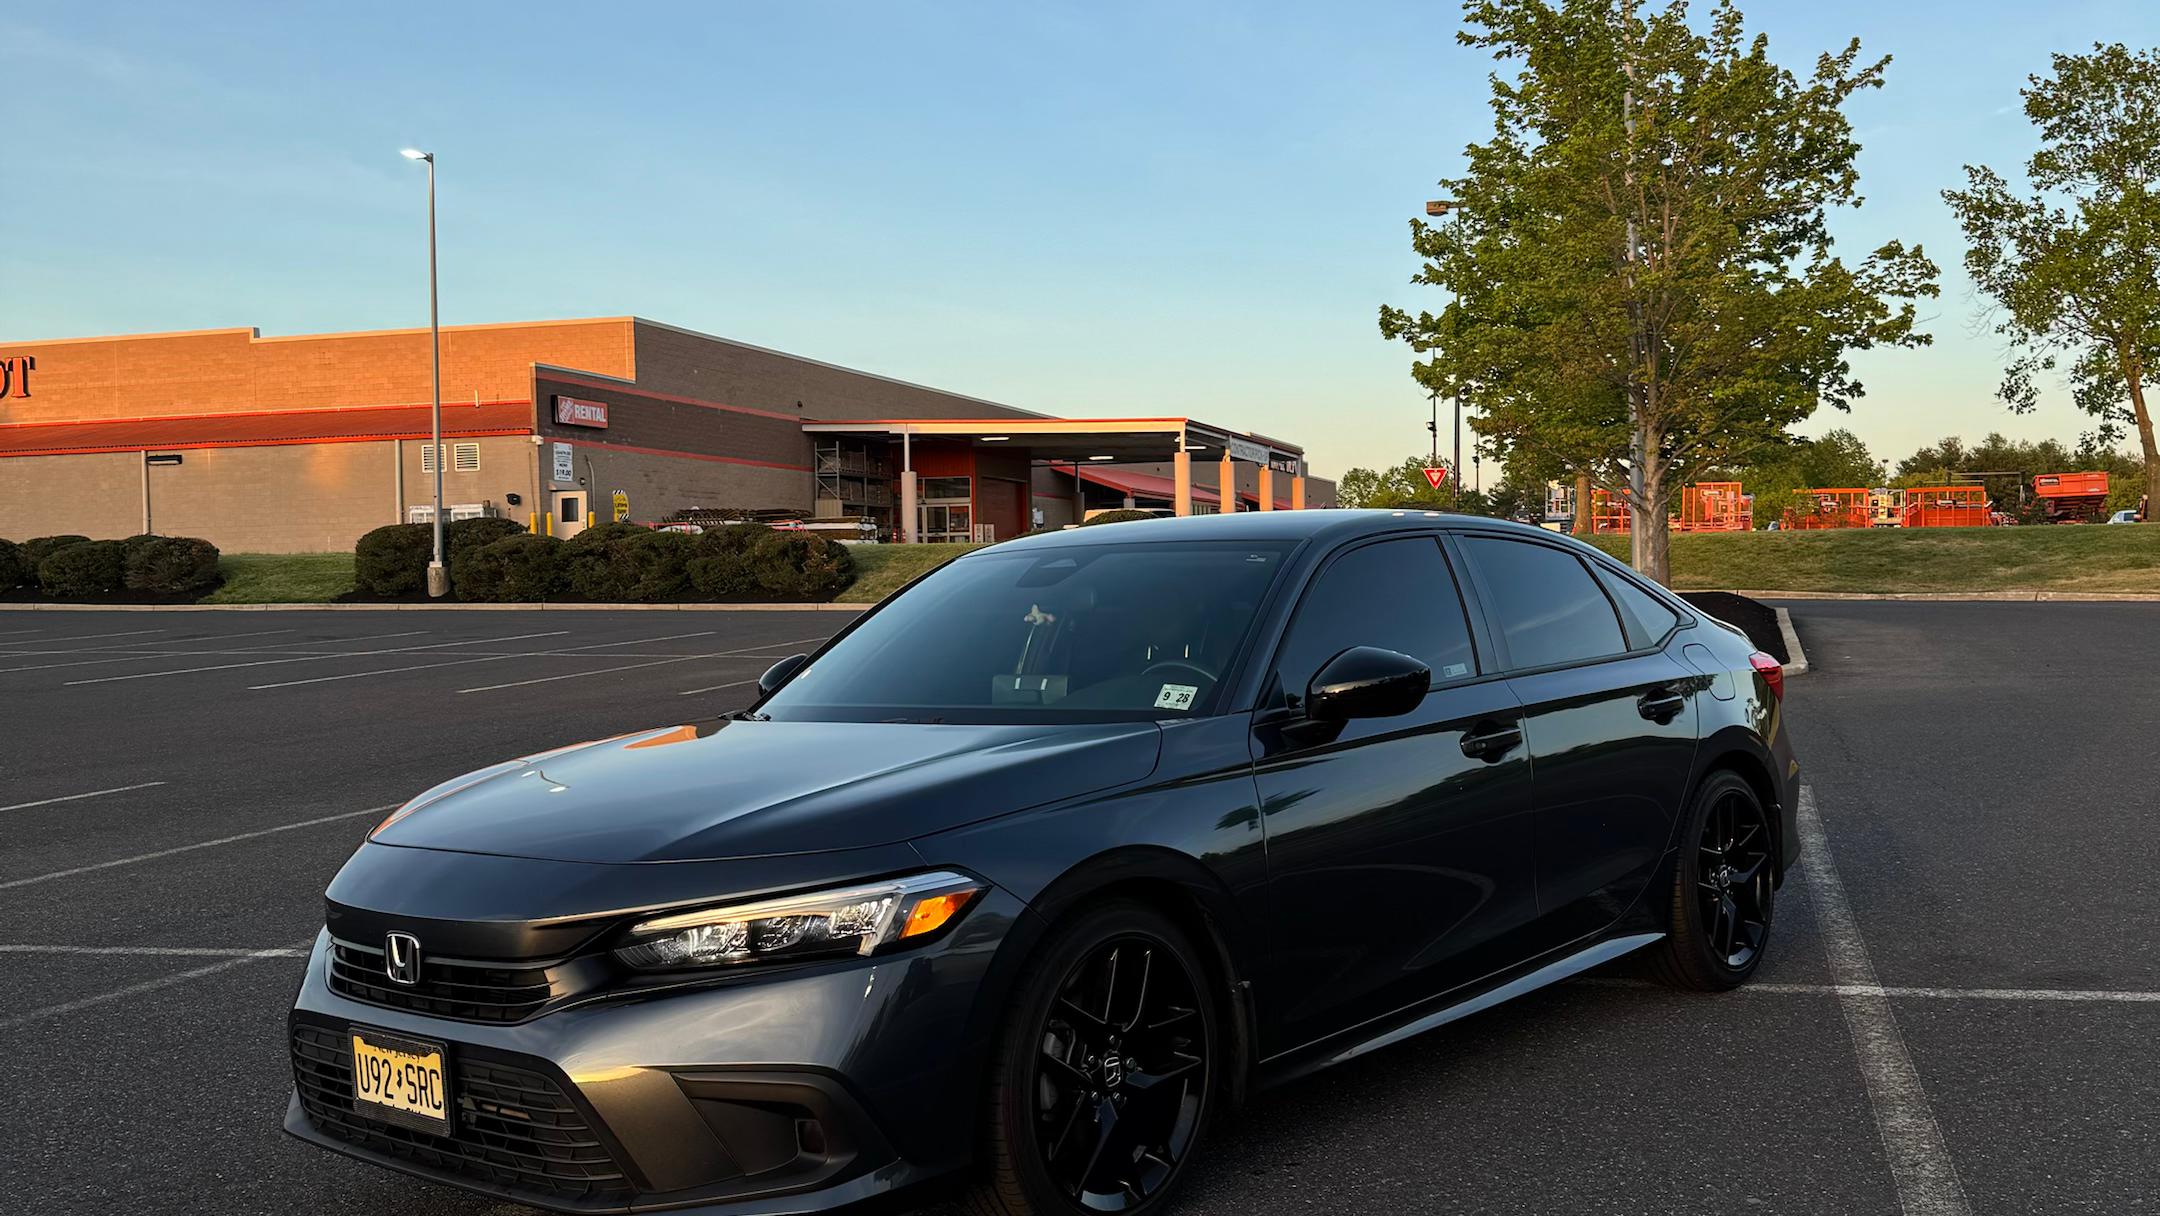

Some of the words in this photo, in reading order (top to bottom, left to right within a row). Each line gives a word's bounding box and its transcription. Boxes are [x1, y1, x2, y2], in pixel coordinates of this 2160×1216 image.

[0, 356, 35, 398] T
[574, 404, 606, 422] RENTAL
[1162, 691, 1171, 701] 9
[1175, 693, 1190, 703] 28
